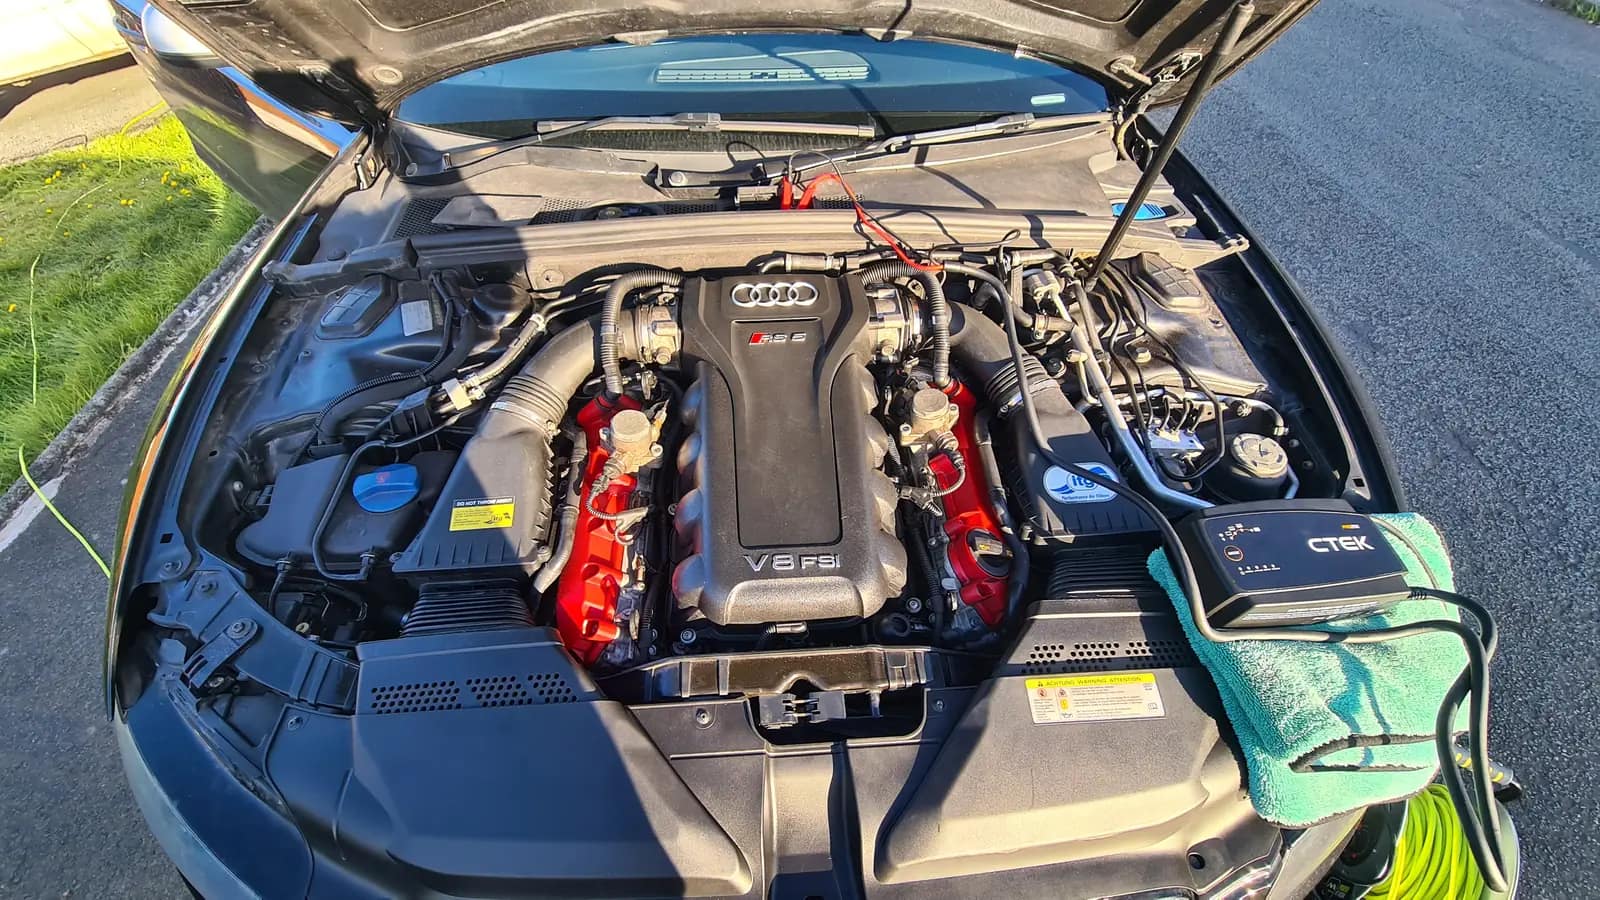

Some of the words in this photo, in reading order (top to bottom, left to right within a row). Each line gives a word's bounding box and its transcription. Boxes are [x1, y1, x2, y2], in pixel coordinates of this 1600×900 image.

[751, 332, 788, 345] RS
[1071, 475, 1095, 488] itg
[1308, 535, 1375, 553] CTEK
[743, 553, 794, 572] V8
[801, 554, 840, 569] FSI
